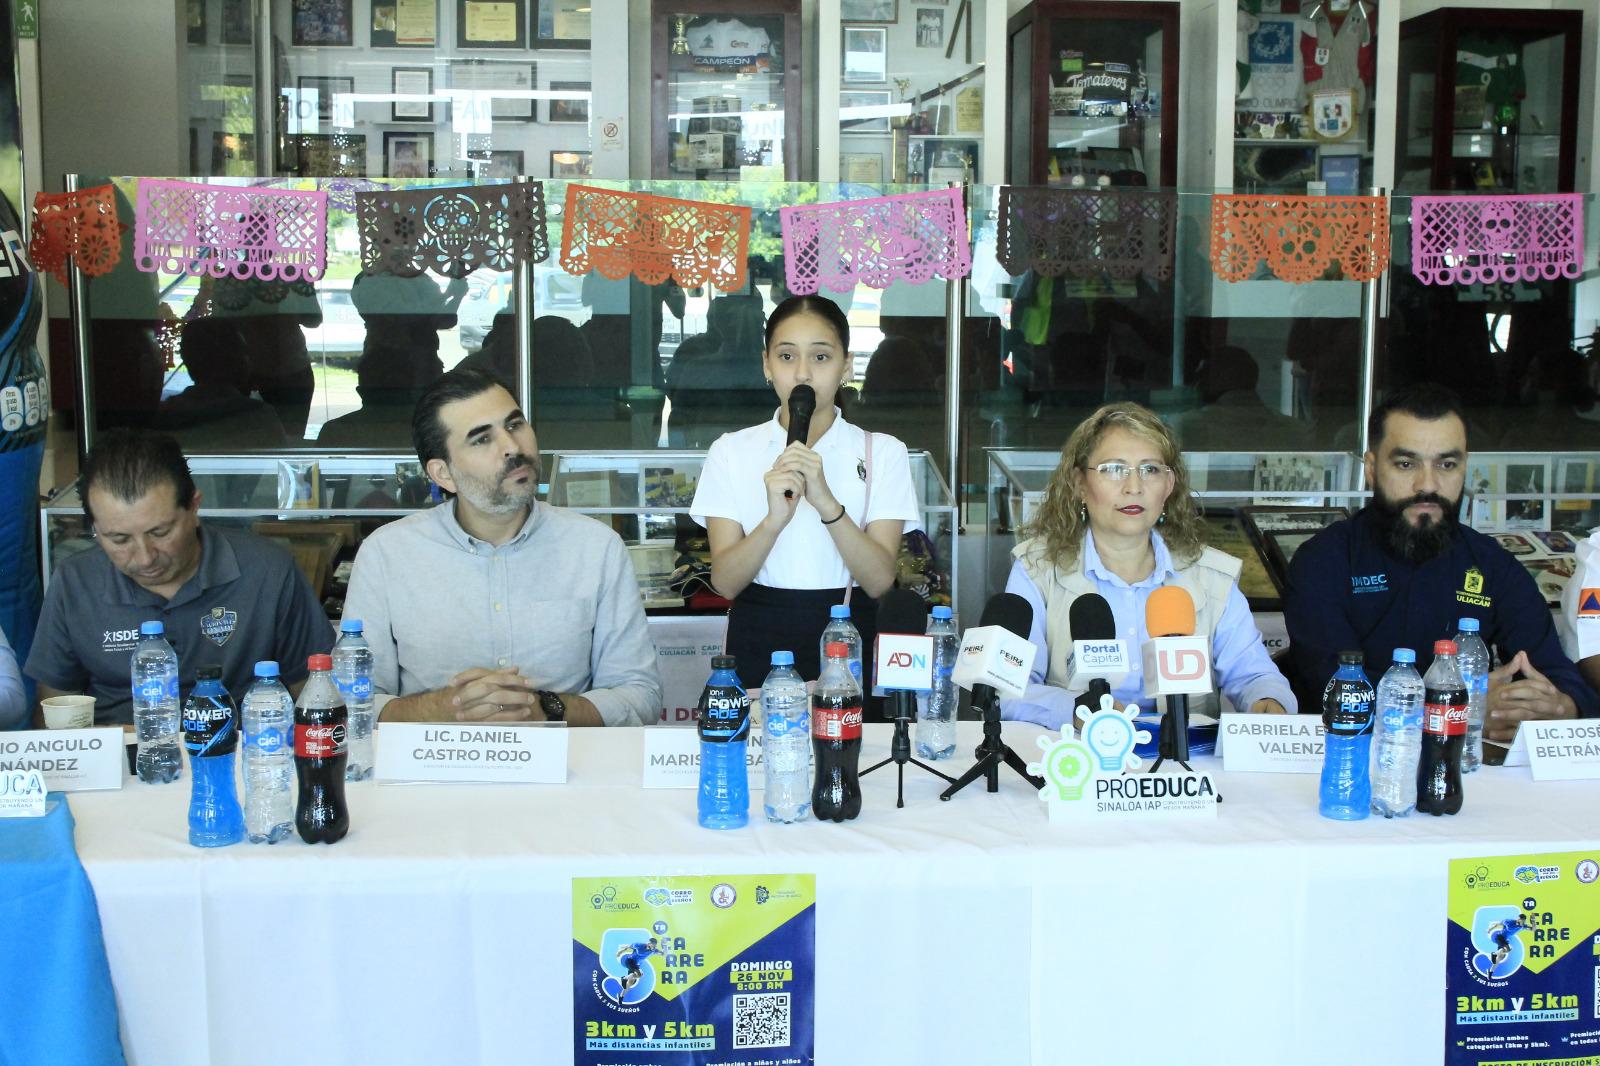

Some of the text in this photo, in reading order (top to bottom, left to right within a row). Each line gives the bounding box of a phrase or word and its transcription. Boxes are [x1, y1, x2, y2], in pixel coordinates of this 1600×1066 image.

[694, 56, 751, 65] CAMPEÓN
[1066, 72, 1127, 91] Tomateros
[1517, 249, 1575, 265] MUERTOS
[1351, 574, 1388, 586] IMDEC
[113, 629, 140, 642] ISDE
[1083, 644, 1120, 653] Portal
[887, 652, 926, 669] ADN
[1082, 653, 1123, 664] Capital
[142, 685, 163, 697] ciel
[352, 682, 370, 694] ciel
[708, 696, 750, 709] POWE
[1340, 702, 1369, 713] ADE
[183, 707, 233, 722] POWER
[708, 708, 739, 719] ADE
[182, 719, 207, 732] ADE
[768, 719, 788, 731] ciel
[1382, 715, 1404, 727] ciel
[1226, 723, 1311, 737] GABRIELA
[1535, 728, 1564, 740] LIC.
[257, 735, 280, 747] ciel
[424, 730, 522, 744] LIC. DANIEL
[24, 738, 103, 754] ANGULO
[412, 748, 532, 762] CASTRO ROJO
[1096, 775, 1214, 800] PROEDUCA
[1097, 800, 1162, 812] SINALOA IAP
[1534, 927, 1570, 942] RRE
[1470, 904, 1526, 980] 5
[1529, 944, 1555, 958] RA
[599, 927, 657, 1005] 5
[665, 953, 705, 968] RRE
[731, 960, 793, 972] DOMINGO
[661, 971, 688, 985] RA
[737, 972, 785, 982] 26 NOV
[736, 981, 784, 991] 8:00 AM
[1456, 993, 1579, 1014] 3km y 5km
[1459, 1011, 1575, 1023] Más distancias infantiles
[585, 1020, 715, 1042] 3km y 5km
[589, 1040, 712, 1049] Más distancias infantiles
[1466, 1035, 1505, 1043] Premiación
